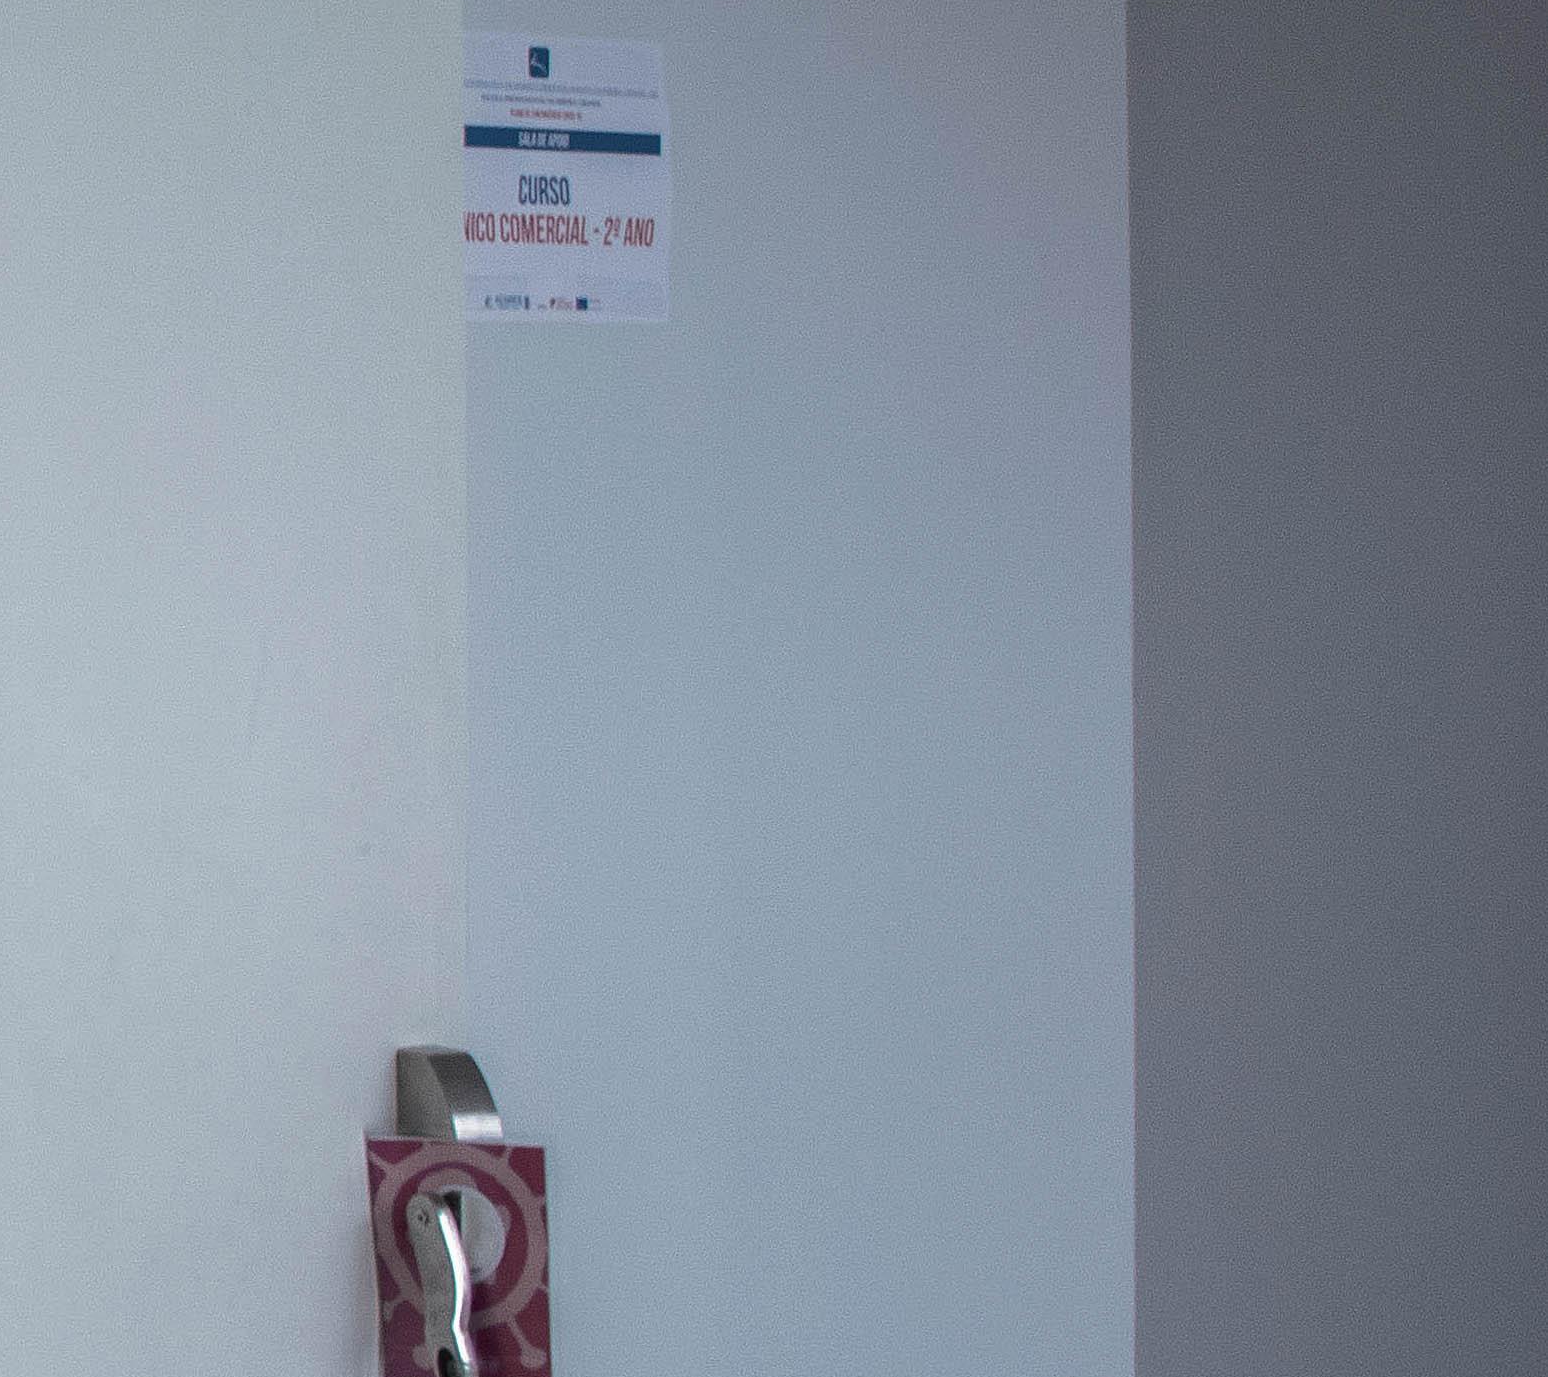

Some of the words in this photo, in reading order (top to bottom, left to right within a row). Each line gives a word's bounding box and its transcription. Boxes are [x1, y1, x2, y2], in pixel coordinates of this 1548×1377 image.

[518, 175, 571, 205] CURSO
[500, 213, 589, 245] COMERCIAL
[624, 217, 655, 247] ANO
